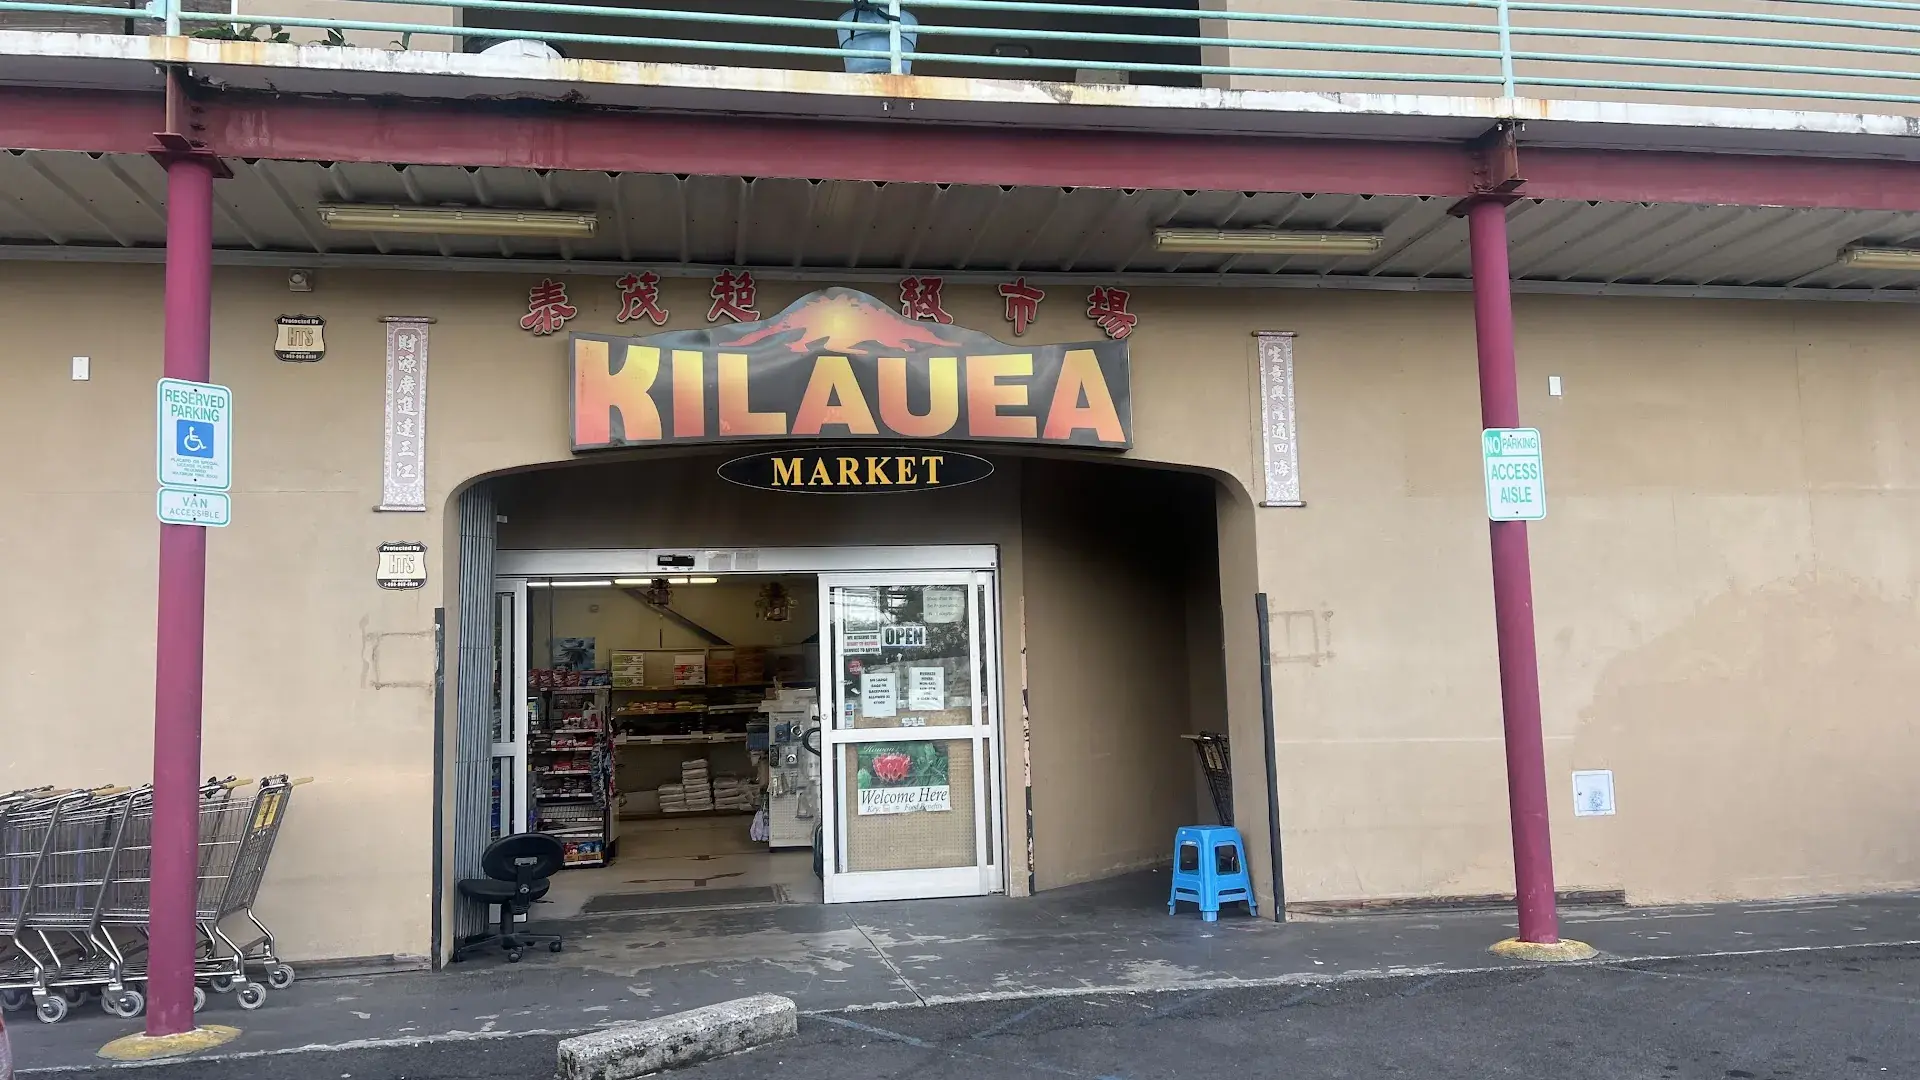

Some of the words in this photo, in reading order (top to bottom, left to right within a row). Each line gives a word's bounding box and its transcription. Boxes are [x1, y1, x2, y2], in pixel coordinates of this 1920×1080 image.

[520, 268, 1138, 340] 泰茂超級市場
[287, 326, 314, 347] HTS
[165, 388, 225, 409] RESERVED
[574, 340, 1126, 446] KILAUEA
[171, 403, 220, 423] PARKING
[1485, 436, 1501, 454] NO
[1502, 437, 1537, 449] PARKING
[771, 455, 945, 486] MARKET
[1491, 462, 1538, 481] ACCESS
[182, 496, 208, 509] VAN
[1500, 486, 1533, 504] AISLE
[169, 507, 220, 519] ACCESSIBLE
[389, 553, 415, 574] HTS
[885, 627, 923, 645] OPEN
[861, 789, 915, 805] Welcome
[918, 787, 948, 802] Here
